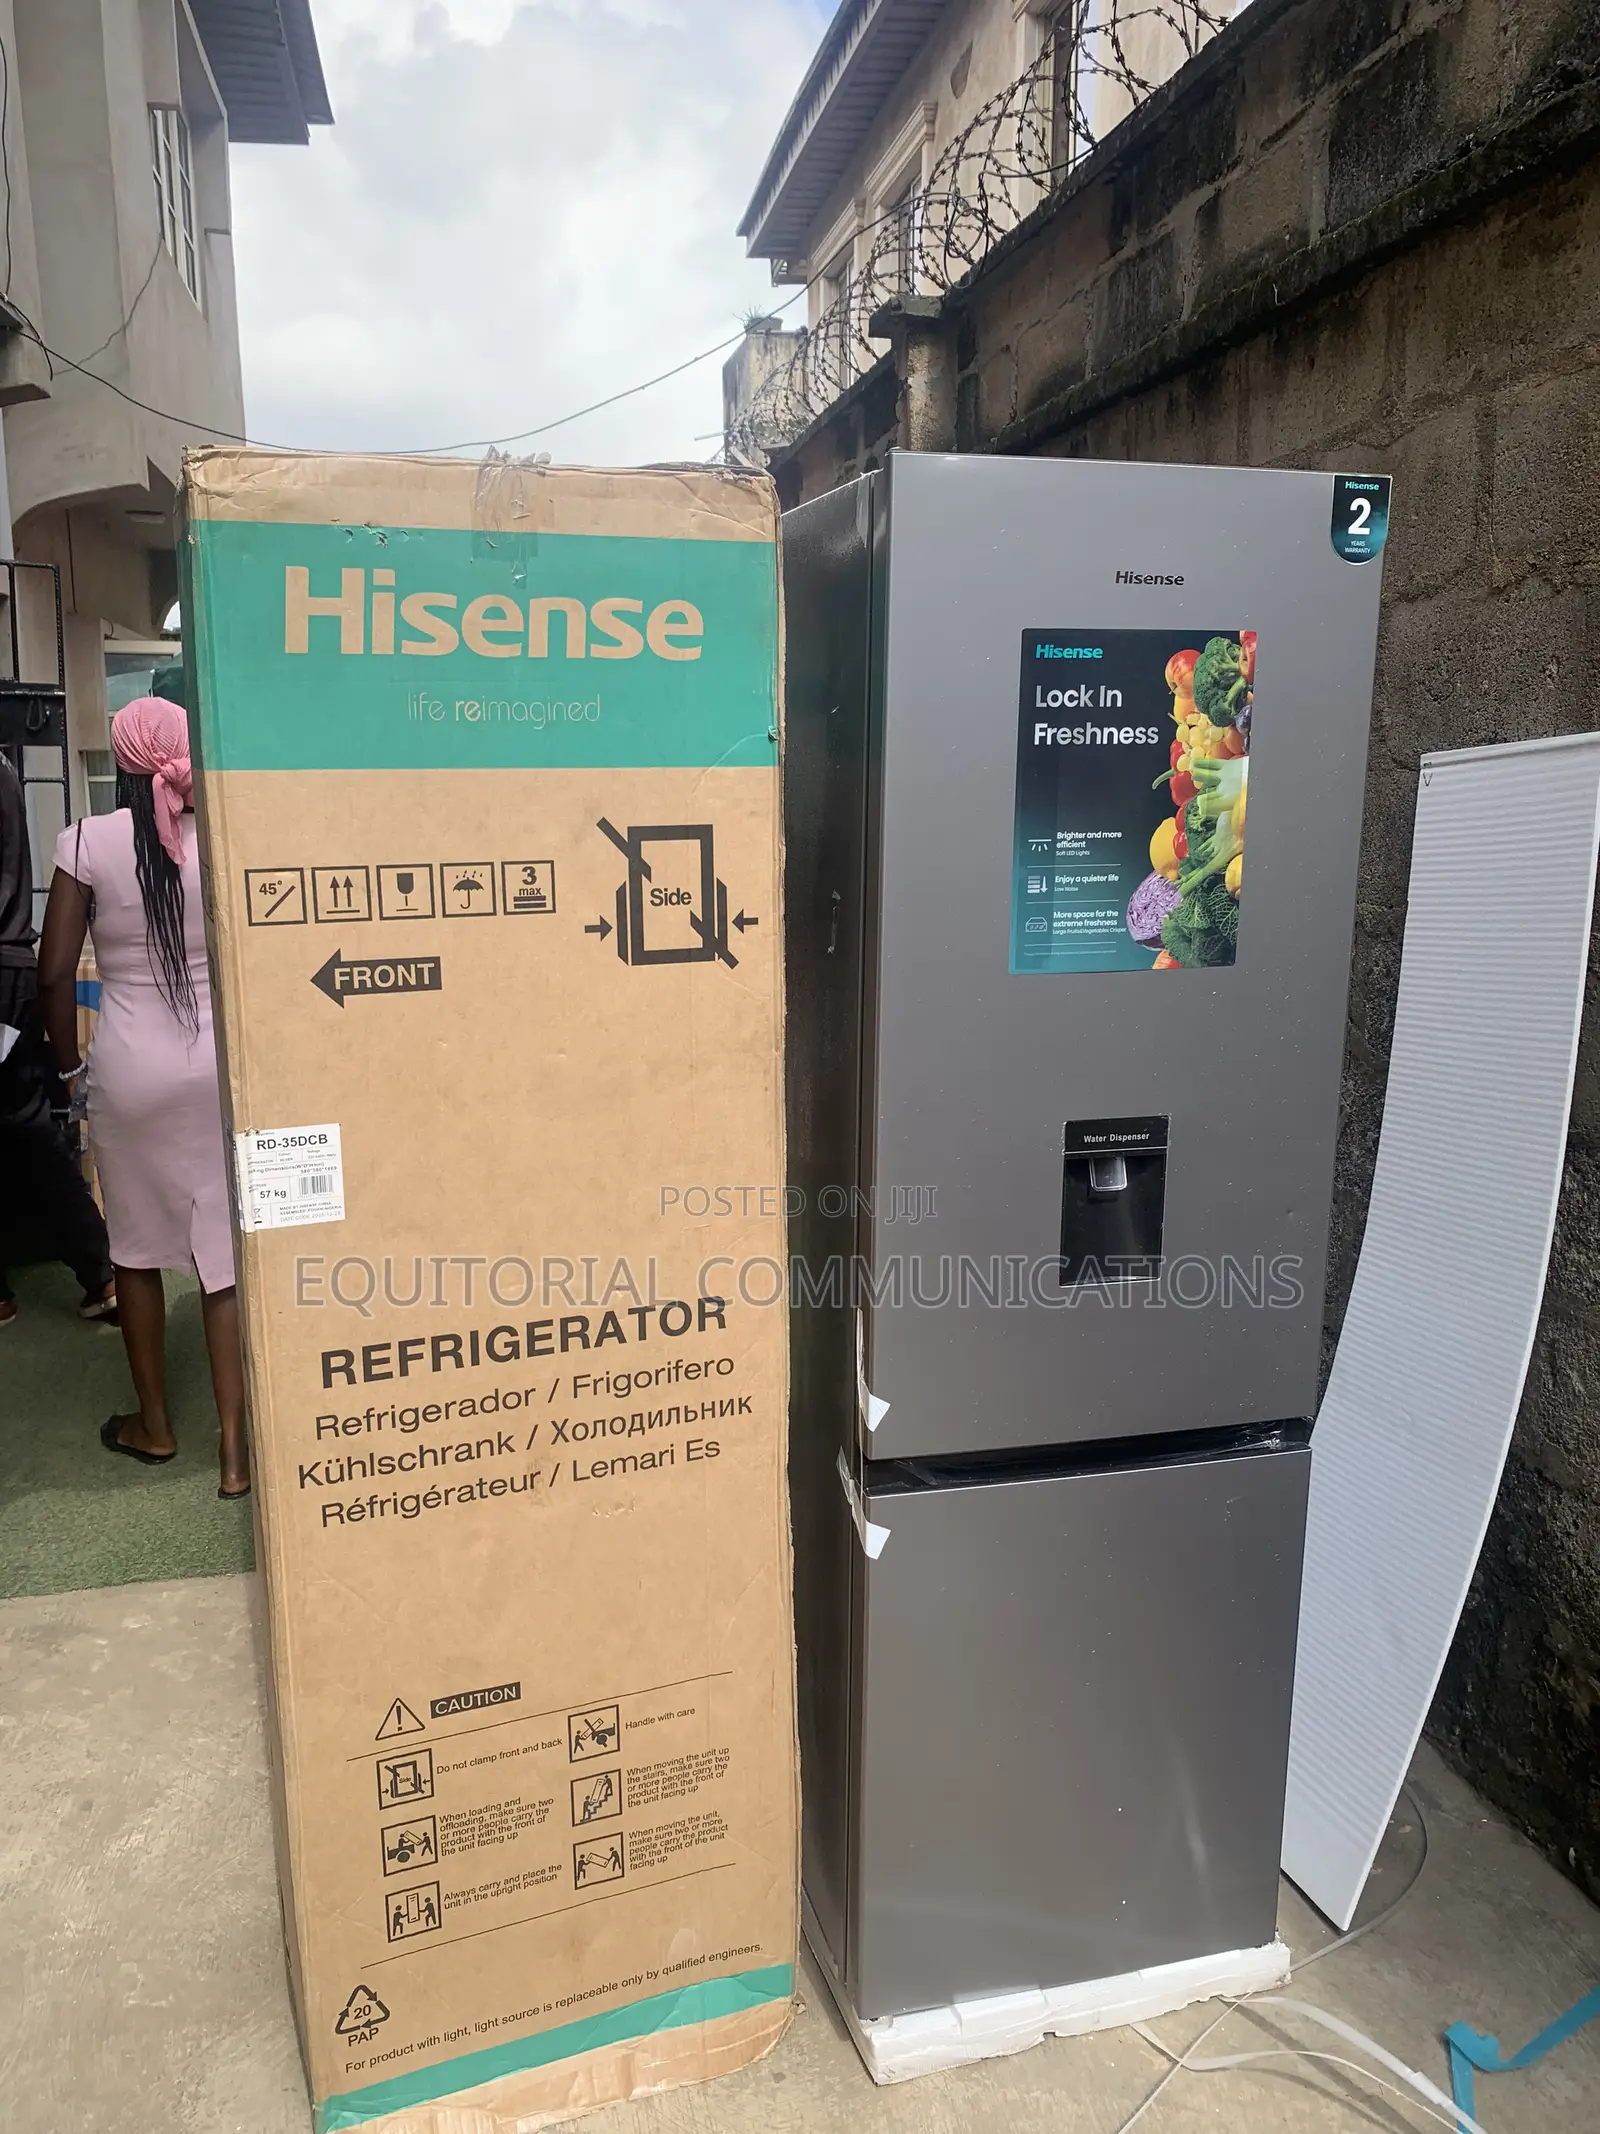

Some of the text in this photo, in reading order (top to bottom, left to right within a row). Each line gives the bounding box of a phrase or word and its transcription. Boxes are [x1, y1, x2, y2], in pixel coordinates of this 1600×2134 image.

[1345, 481, 1379, 490] Hisense
[1348, 497, 1371, 535] 2
[1115, 570, 1185, 586] Hisense
[284, 566, 704, 661] Hisense
[1035, 643, 1104, 659] Hisense
[1035, 684, 1123, 708] Lock In
[407, 691, 601, 730] life reimagined
[1033, 722, 1160, 746] Freshness
[1056, 830, 1122, 841] Brighter and more
[1056, 840, 1086, 849] efficient
[522, 866, 538, 885] 3
[1054, 873, 1120, 885] Enjoy quieter life
[518, 886, 542, 896] max
[649, 886, 692, 907] Side
[1053, 911, 1072, 919] More
[1072, 911, 1095, 920] space
[1083, 919, 1118, 927] freshness
[334, 962, 435, 990] FRONT
[257, 1134, 328, 1151] RD-35DCB
[1083, 1133, 1150, 1144] Water Dispenser
[260, 1190, 271, 1199] 57
[274, 1189, 287, 1199] kg
[320, 1295, 727, 1389] REFRIGERATOR
[315, 1356, 735, 1440] Refrigerador / Frigorifero
[550, 1395, 753, 1446] Холодильник
[299, 1424, 539, 1490] Kühlschrank /
[322, 1439, 721, 1528] Réfrigérateur / Lemari Es
[435, 1685, 517, 1715] CAUTION
[625, 1708, 696, 1730] Handle with care
[436, 1738, 563, 1774] Do not clamp front and back
[626, 1747, 729, 1777] When moving the unit up
[627, 1755, 730, 1785] the stairs, make sure two
[627, 1762, 728, 1793] or more people carry the
[627, 1770, 724, 1800] product with the front of
[439, 1797, 521, 1824] When loading and
[628, 1785, 699, 1808] the unit facing up
[440, 1798, 554, 1832] offloading, make sure two
[452, 1826, 476, 1838] more
[478, 1818, 509, 1832] people
[511, 1811, 533, 1823] carry
[535, 1807, 550, 1816] the
[628, 1810, 720, 1839] When moving the unit,
[440, 1815, 546, 1848] product with the front of
[441, 1831, 519, 1856] the unit facing up
[629, 1818, 723, 1847] make sure two or more
[629, 1824, 728, 1856] people carry the product
[629, 1832, 725, 1863] with the front of the unit
[629, 1855, 668, 1870] facing up
[443, 1864, 562, 1902] Always carry and place the
[444, 1873, 557, 1910] unit in the upright position
[345, 1942, 763, 2073] For product with light, light source is replaceable only by qualified engineers.
[353, 2004, 372, 2020] 20
[348, 2027, 379, 2047] PAP
